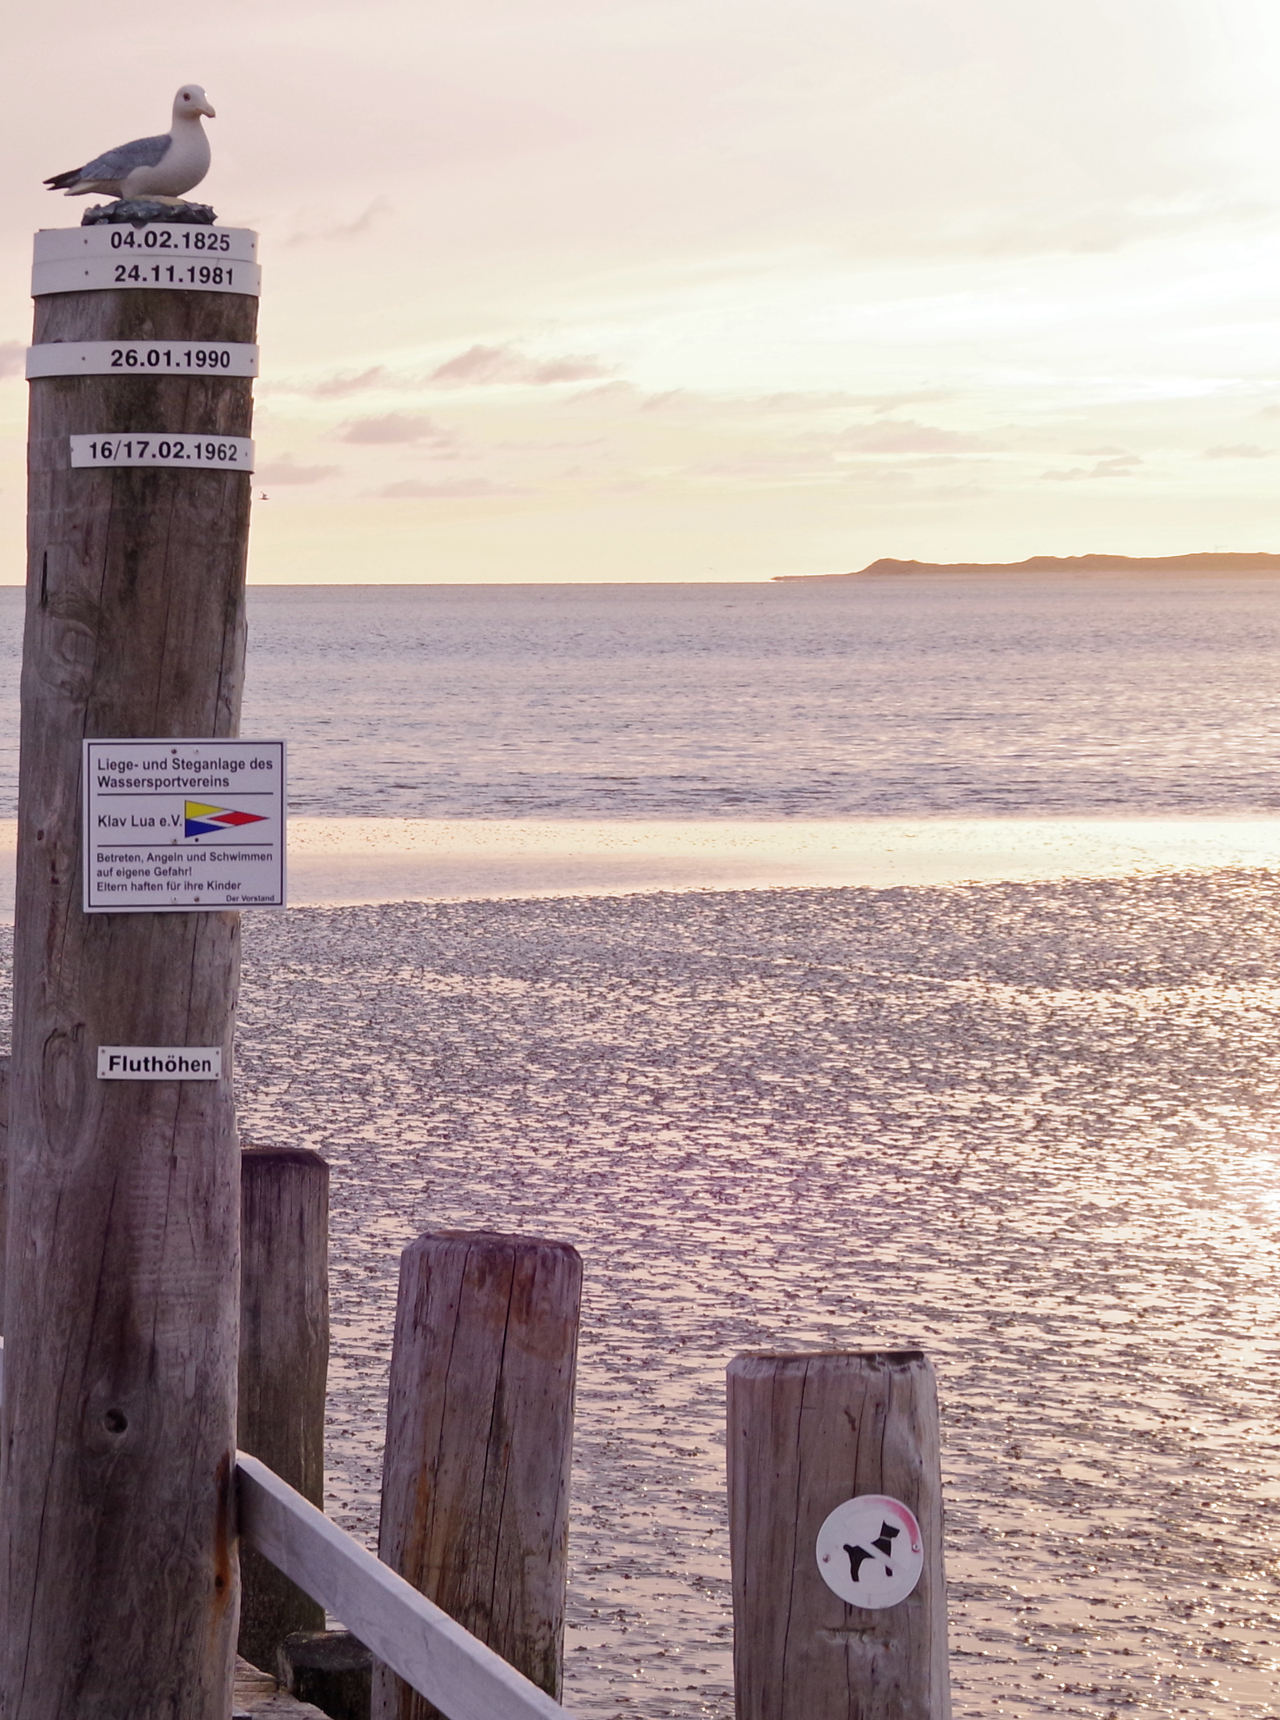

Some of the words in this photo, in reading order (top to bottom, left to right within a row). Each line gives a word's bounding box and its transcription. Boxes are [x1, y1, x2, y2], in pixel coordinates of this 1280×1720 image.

[110, 230, 231, 252] 04.02.1825
[114, 264, 234, 286] 24.11.1981
[110, 348, 231, 369] 26.01.1990
[89, 439, 238, 462] 16/17.02.1962
[97, 758, 139, 774] Liege-
[142, 758, 168, 771] und
[171, 757, 246, 773] Steganlage
[249, 757, 274, 770] des
[97, 775, 230, 790] Wassersportvereins
[97, 814, 128, 828] Klav
[131, 814, 156, 828] Lua
[159, 814, 183, 828] e.V.
[96, 852, 144, 865] Betreten,
[146, 852, 184, 865] Angeln
[186, 852, 207, 863] und
[209, 851, 273, 863] Schwimmen
[96, 867, 114, 878] auf
[115, 867, 151, 879] eigene
[153, 866, 193, 878] Gefahr!
[96, 881, 128, 893] Eltern
[130, 881, 164, 892] haften
[166, 880, 182, 891] für
[183, 880, 204, 891] ihre
[206, 879, 242, 891] Kinder
[225, 894, 240, 903] Der
[241, 894, 276, 903] Vorstand
[108, 1055, 212, 1073] Fluthöhen
